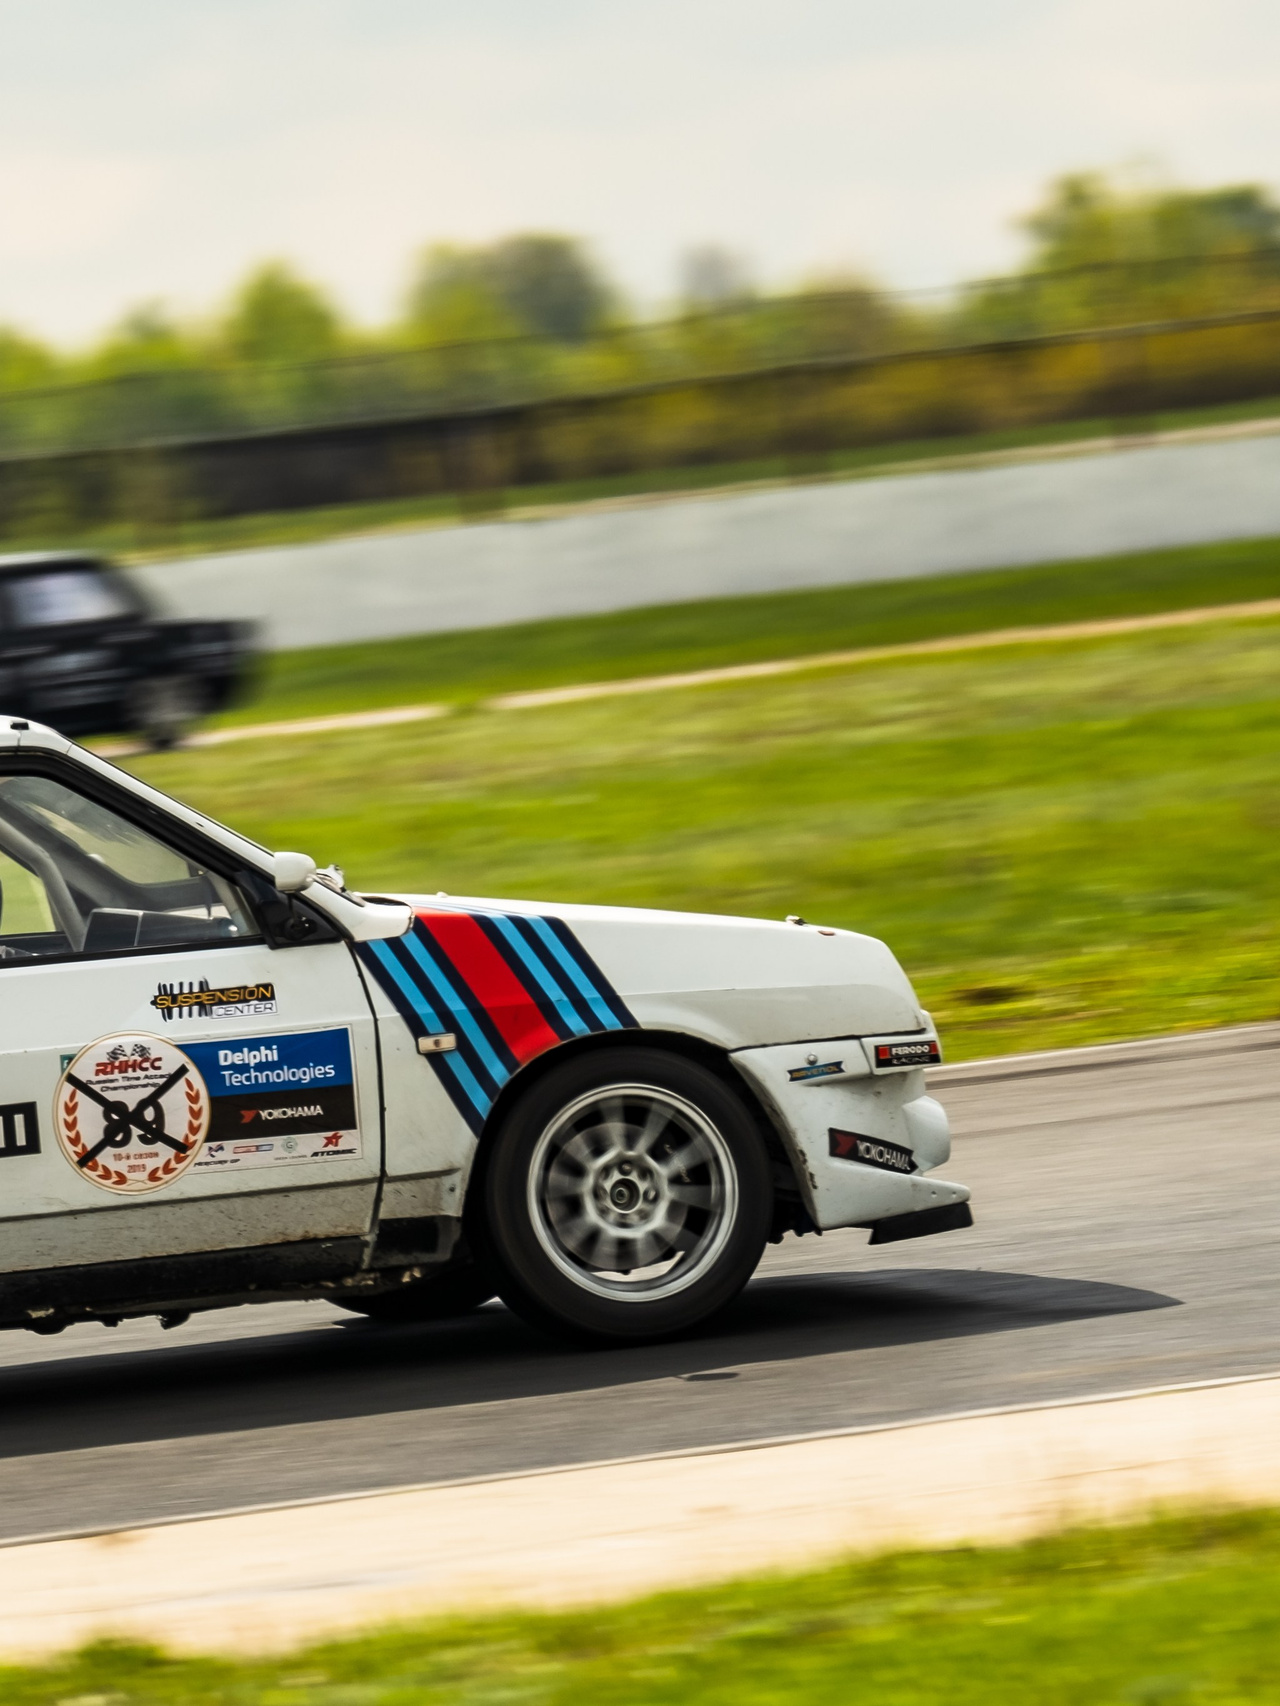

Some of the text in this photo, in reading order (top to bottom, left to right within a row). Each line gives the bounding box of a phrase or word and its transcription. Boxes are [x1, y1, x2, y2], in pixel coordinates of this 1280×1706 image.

[155, 985, 272, 1008] SUSPENSION
[215, 1002, 274, 1017] CENTER
[218, 1045, 279, 1067] Delphi
[891, 1044, 930, 1056] FERODO
[94, 1056, 163, 1077] RHHCC
[220, 1062, 336, 1087] Technologies
[258, 1104, 324, 1121] YOKOHAMA
[310, 1148, 358, 1157] ATOMIC
[856, 1139, 911, 1171] YOKOHAMA
